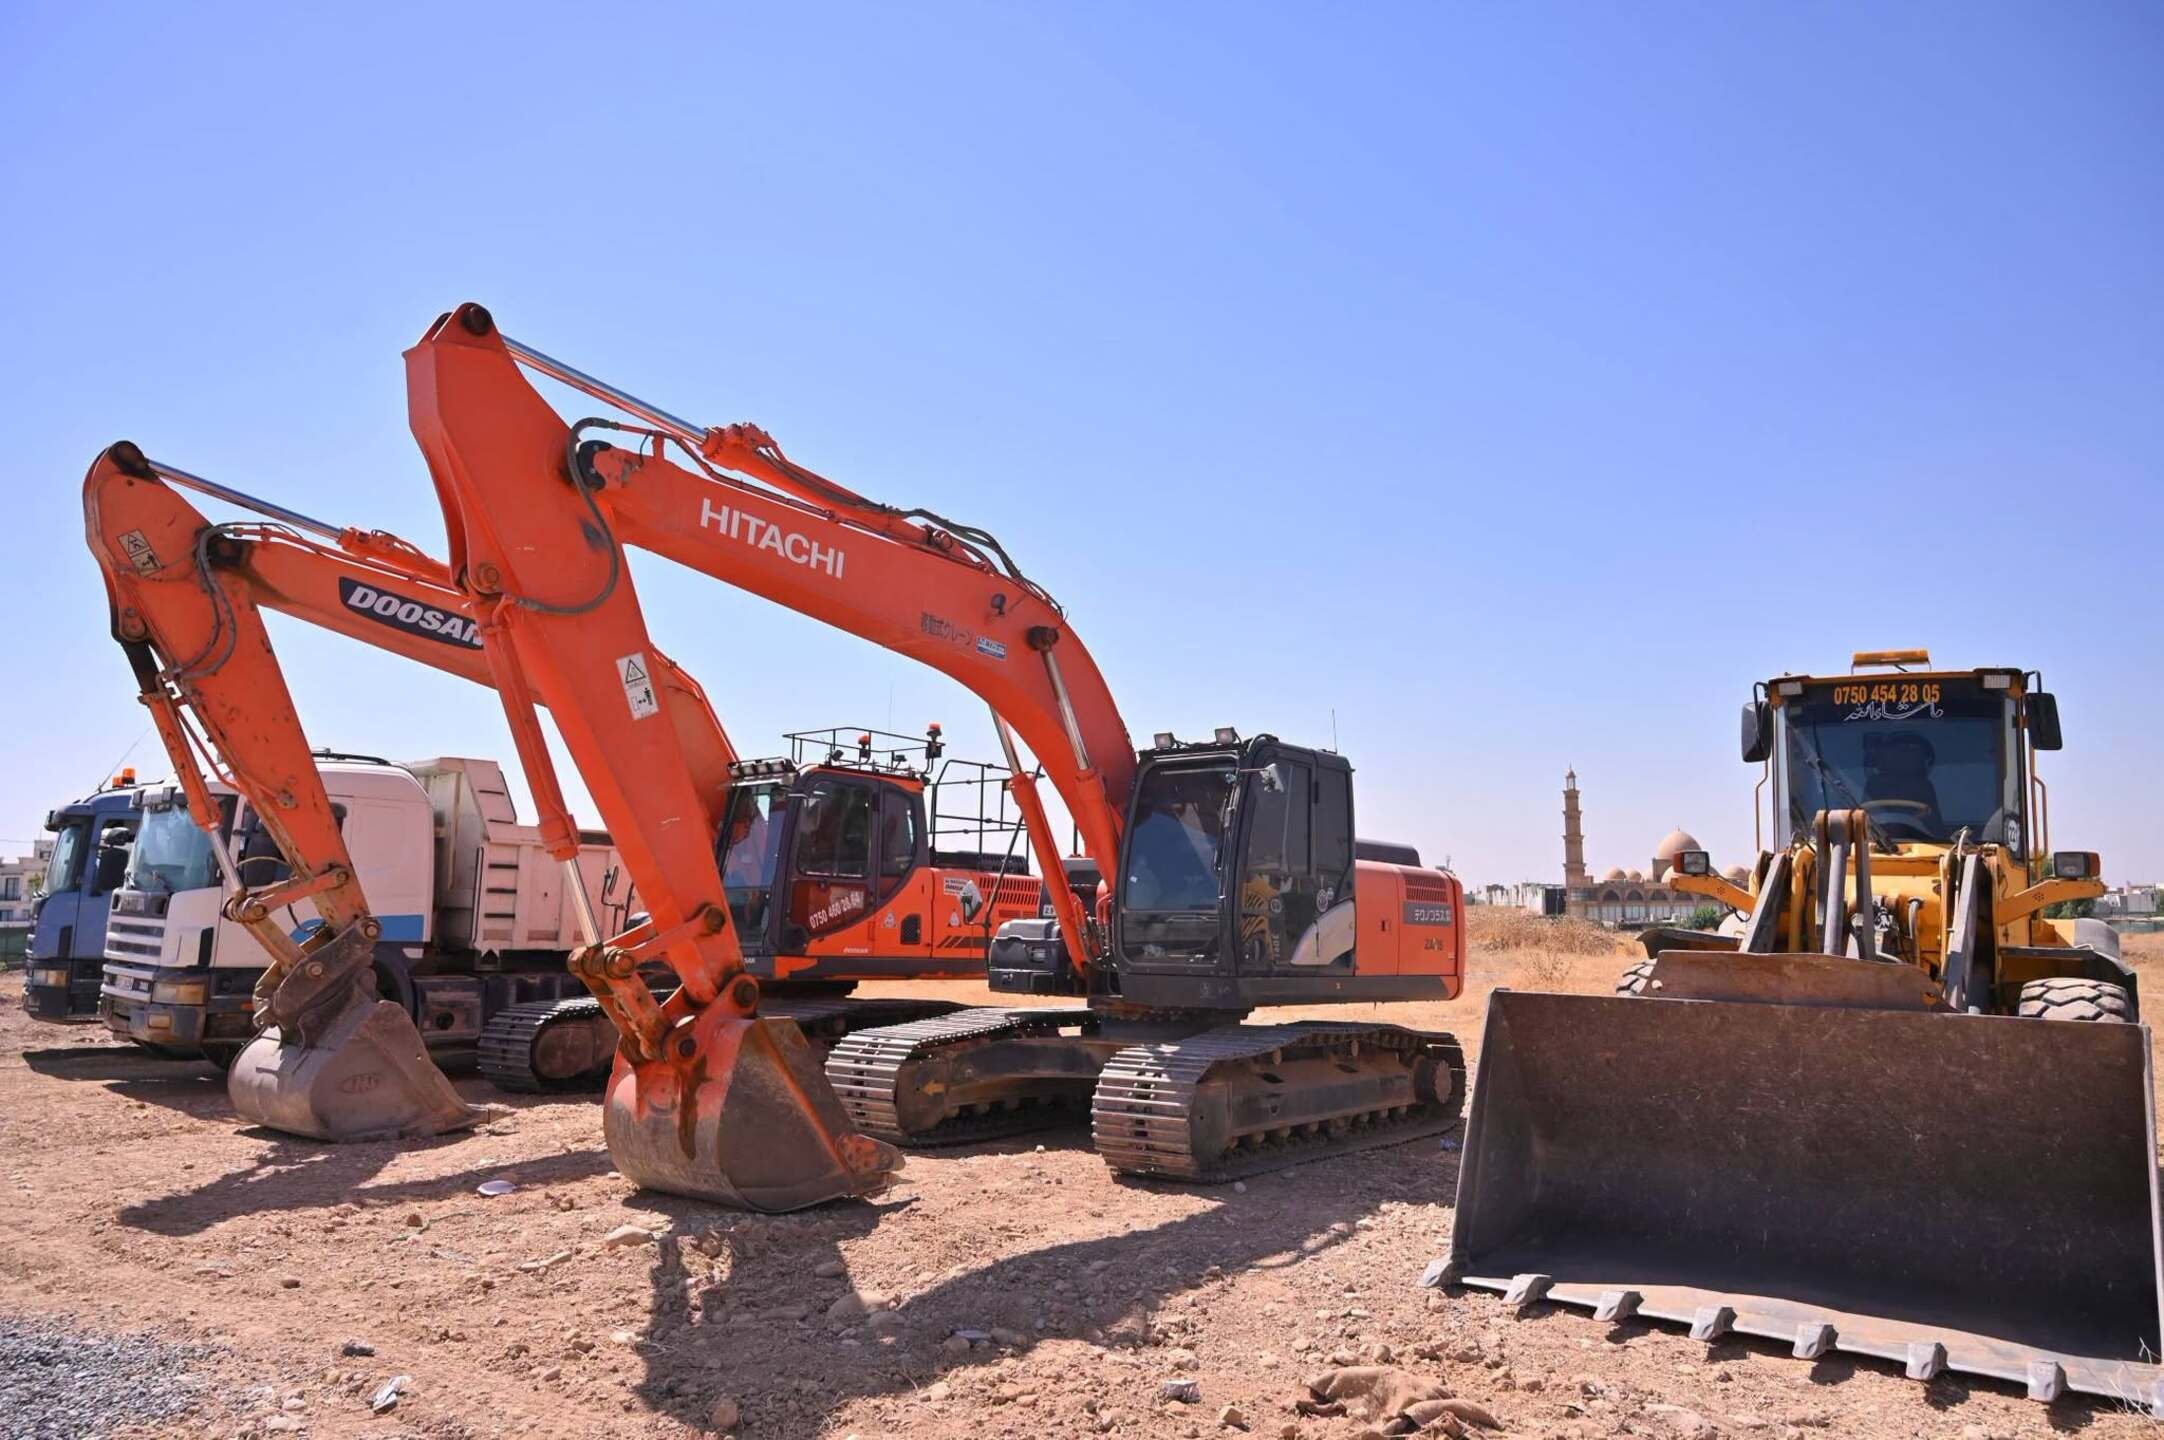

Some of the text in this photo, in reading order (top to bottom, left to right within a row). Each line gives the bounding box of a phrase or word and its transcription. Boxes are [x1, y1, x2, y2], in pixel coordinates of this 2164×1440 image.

[701, 498, 845, 579] HITACHI
[348, 586, 483, 646] DOOSAN
[1834, 684, 1940, 705] 0750 454 28 05
[809, 909, 828, 929] 0750
